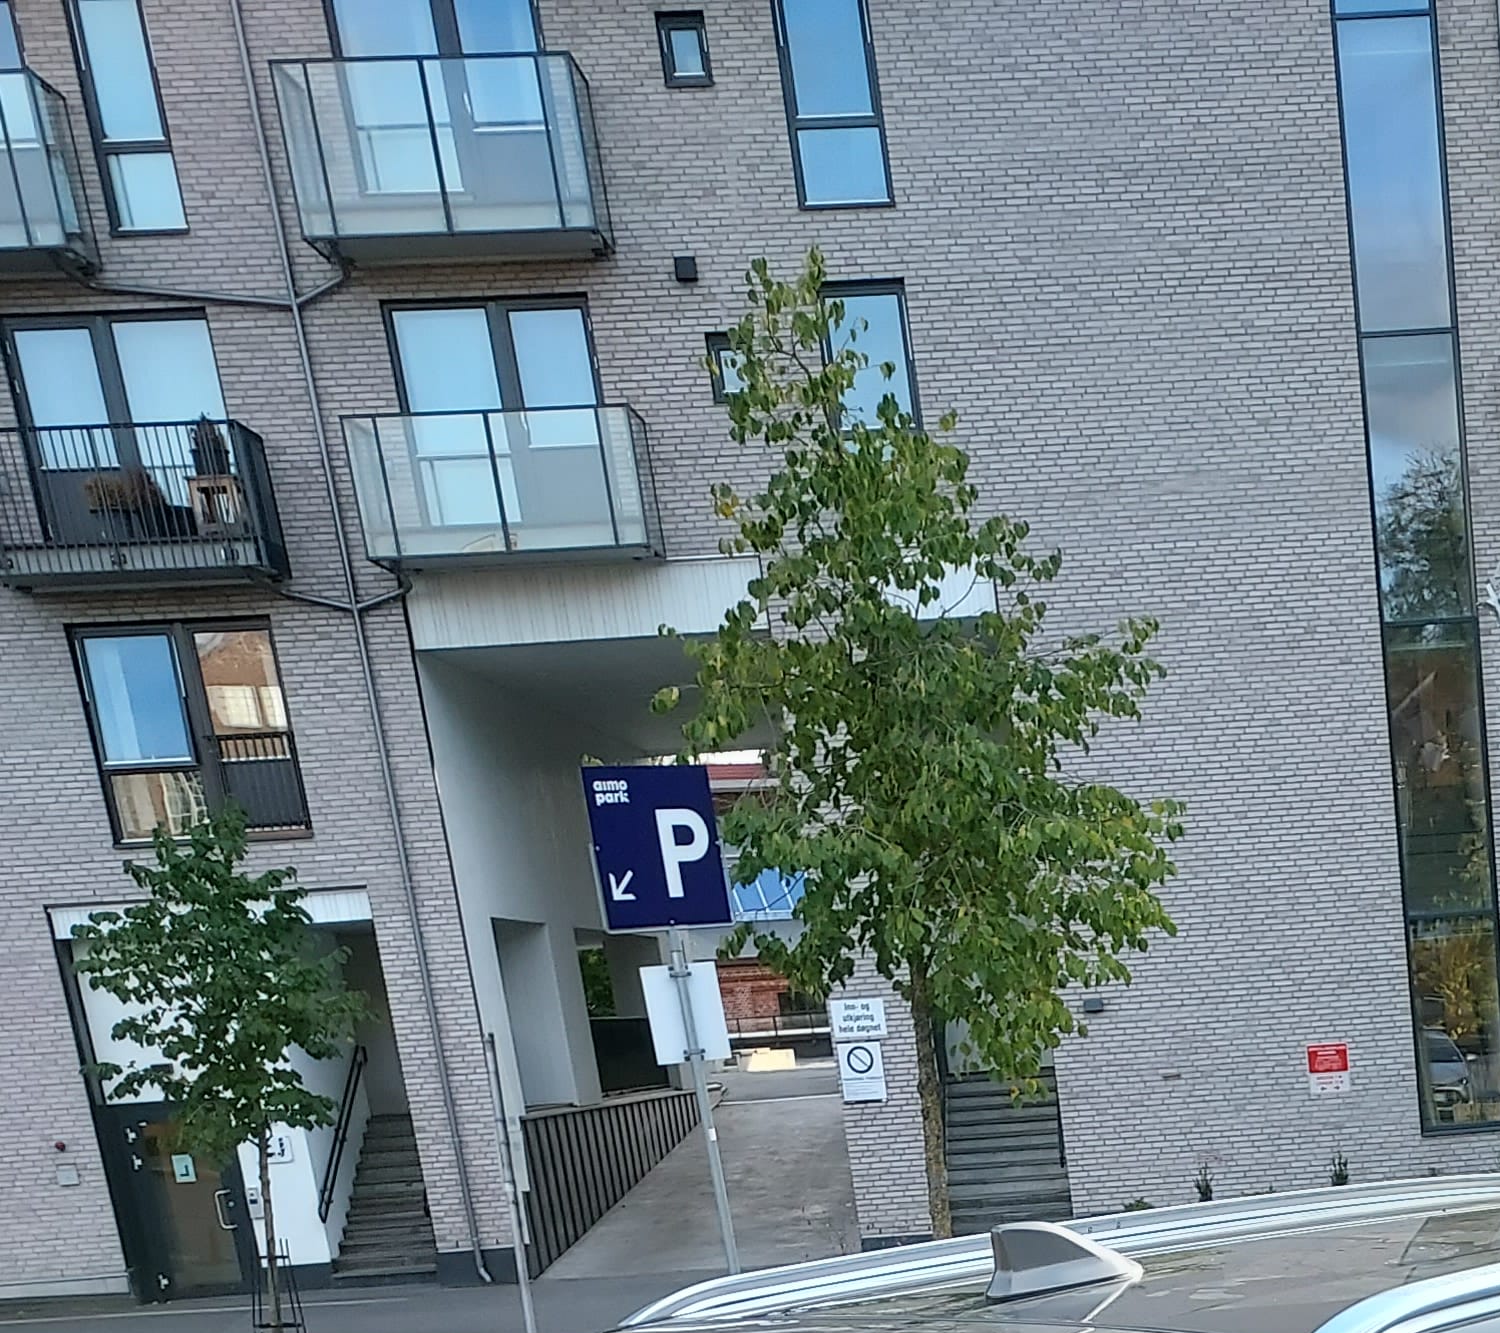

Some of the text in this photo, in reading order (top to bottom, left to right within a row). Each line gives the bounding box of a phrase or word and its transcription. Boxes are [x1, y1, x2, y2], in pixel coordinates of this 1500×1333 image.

[593, 780, 628, 791] aimo
[595, 791, 630, 806] park
[655, 808, 709, 898] P
